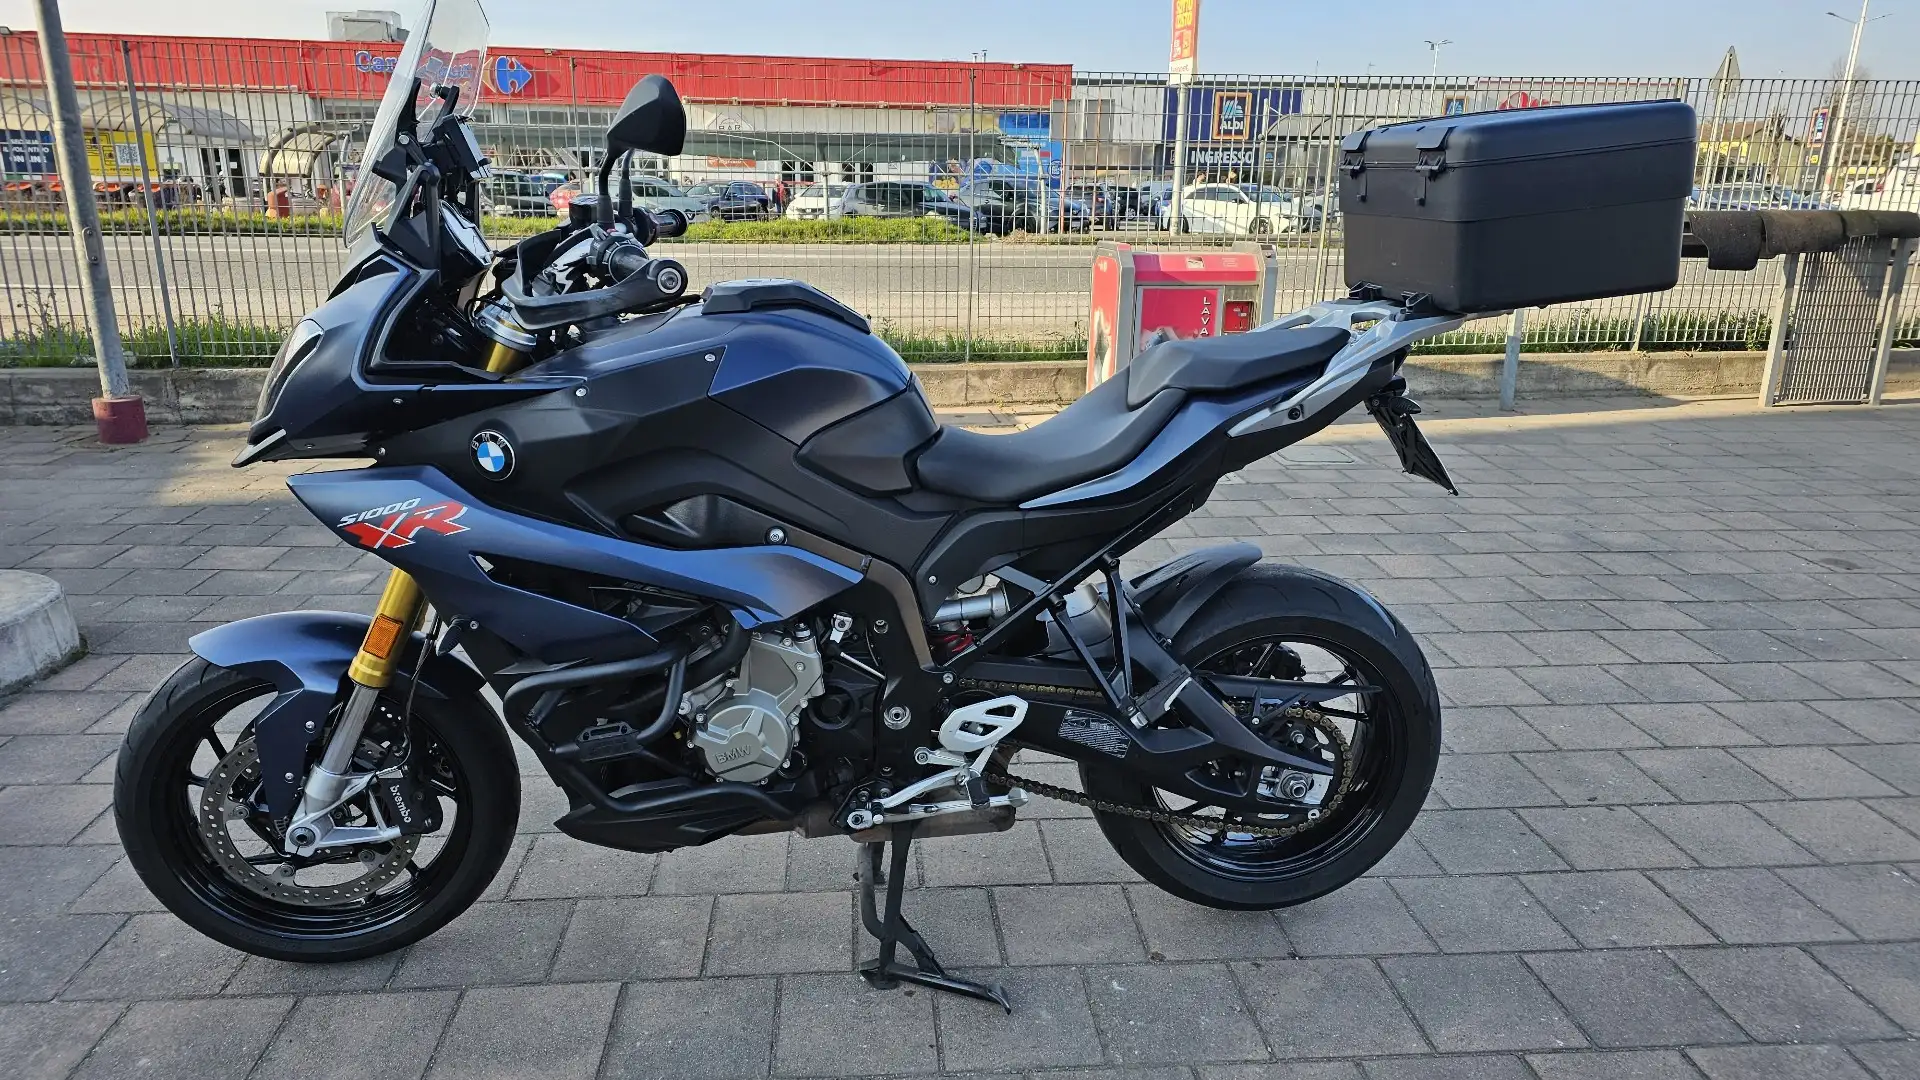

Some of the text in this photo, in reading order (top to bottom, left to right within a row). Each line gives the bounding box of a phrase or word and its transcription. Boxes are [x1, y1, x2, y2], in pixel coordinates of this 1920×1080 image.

[1220, 120, 1244, 130] ALDI
[1190, 150, 1253, 164] INGRESSO
[471, 432, 507, 450] BMW
[336, 497, 422, 528] S1000
[342, 501, 471, 549] XR
[714, 744, 752, 764] BMW
[389, 784, 412, 823] brembo
